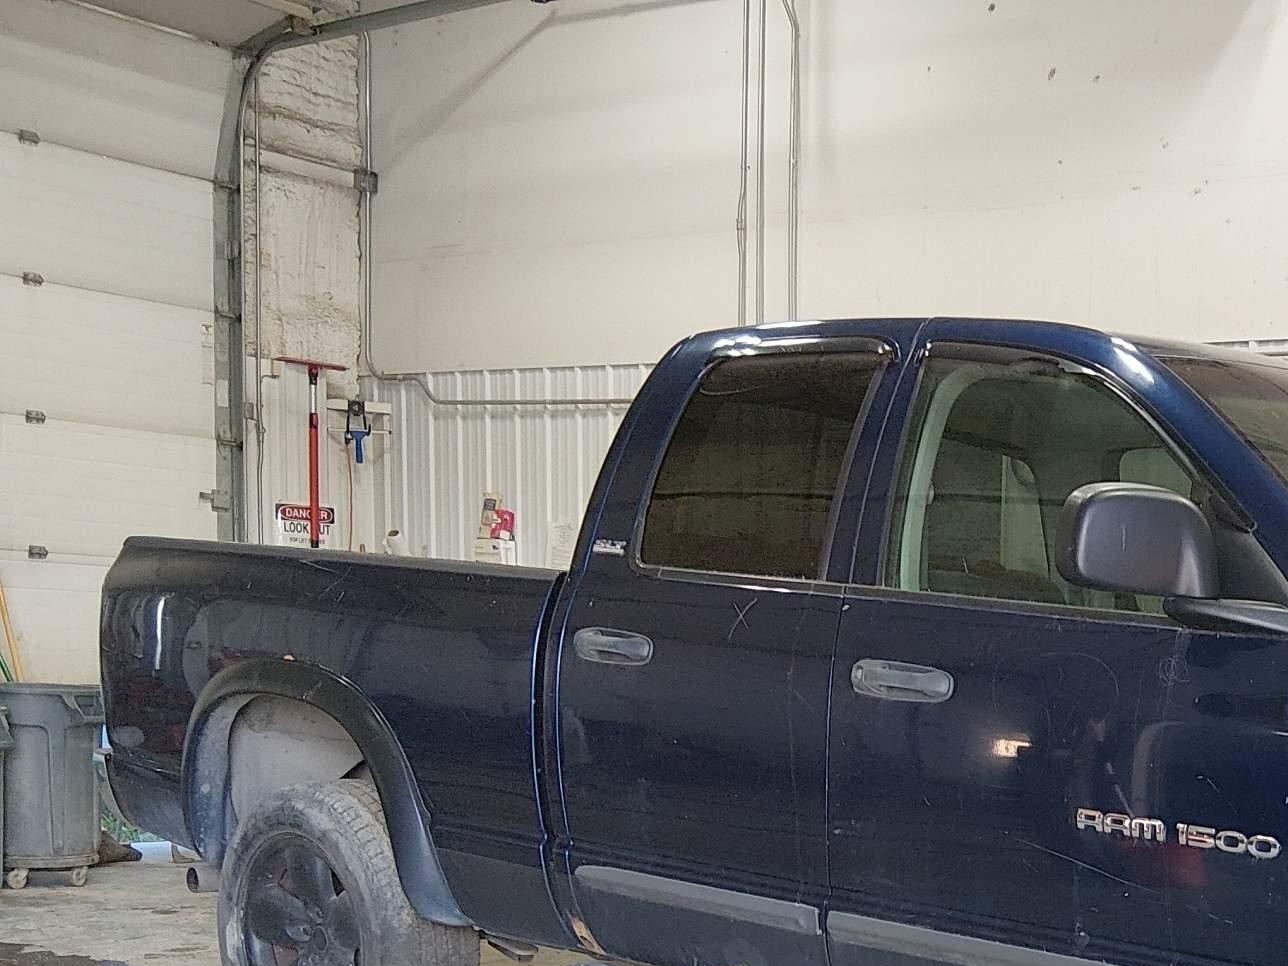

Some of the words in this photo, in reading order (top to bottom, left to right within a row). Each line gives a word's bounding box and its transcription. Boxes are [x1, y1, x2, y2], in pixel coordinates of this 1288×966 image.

[286, 508, 328, 520] DANGR
[284, 522, 309, 534] LOOK
[317, 525, 330, 536] UT
[1076, 807, 1166, 843] RAM
[1176, 822, 1282, 860] 1500
